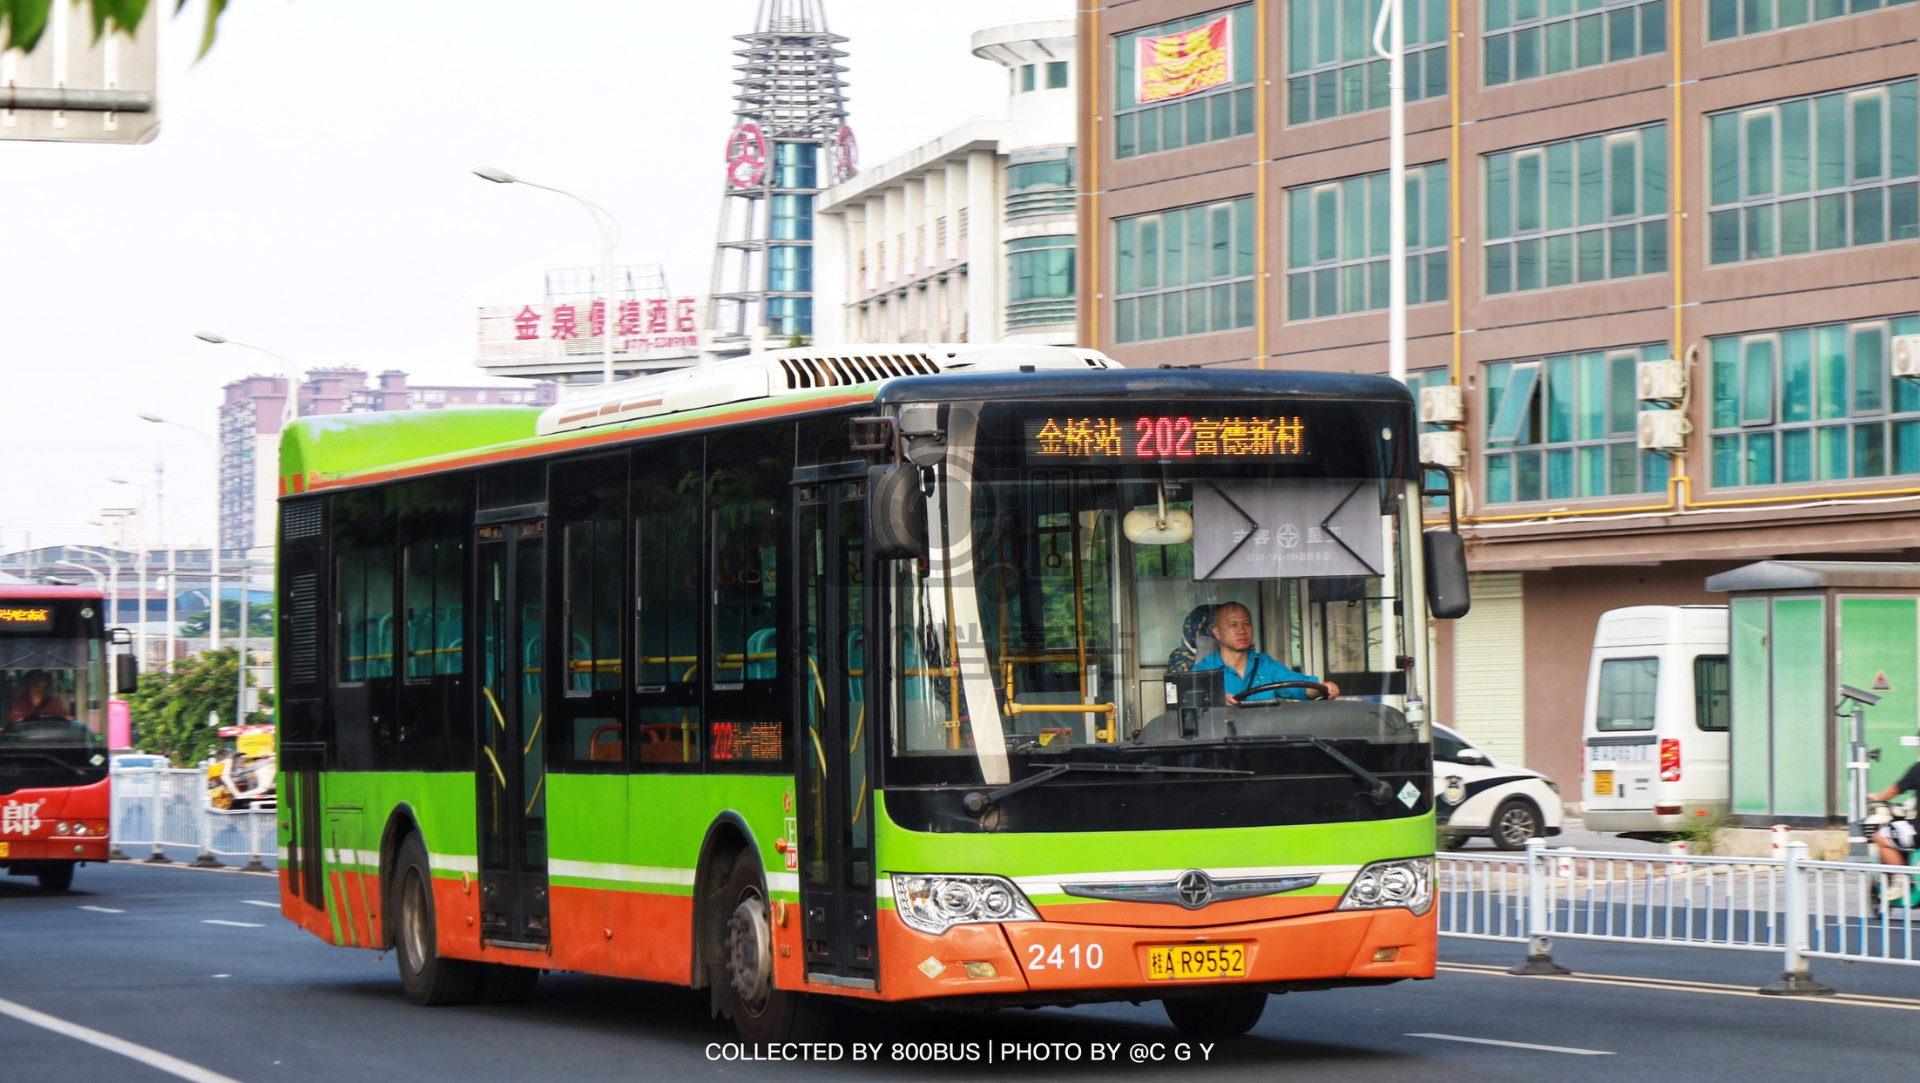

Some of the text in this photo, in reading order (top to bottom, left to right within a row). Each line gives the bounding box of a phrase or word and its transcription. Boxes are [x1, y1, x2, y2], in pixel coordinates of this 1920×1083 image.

[1036, 417, 1304, 456] 金桥站 202 富德新村
[2, 799, 41, 836] 郎
[787, 852, 796, 867] UP
[1028, 943, 1103, 970] 2410
